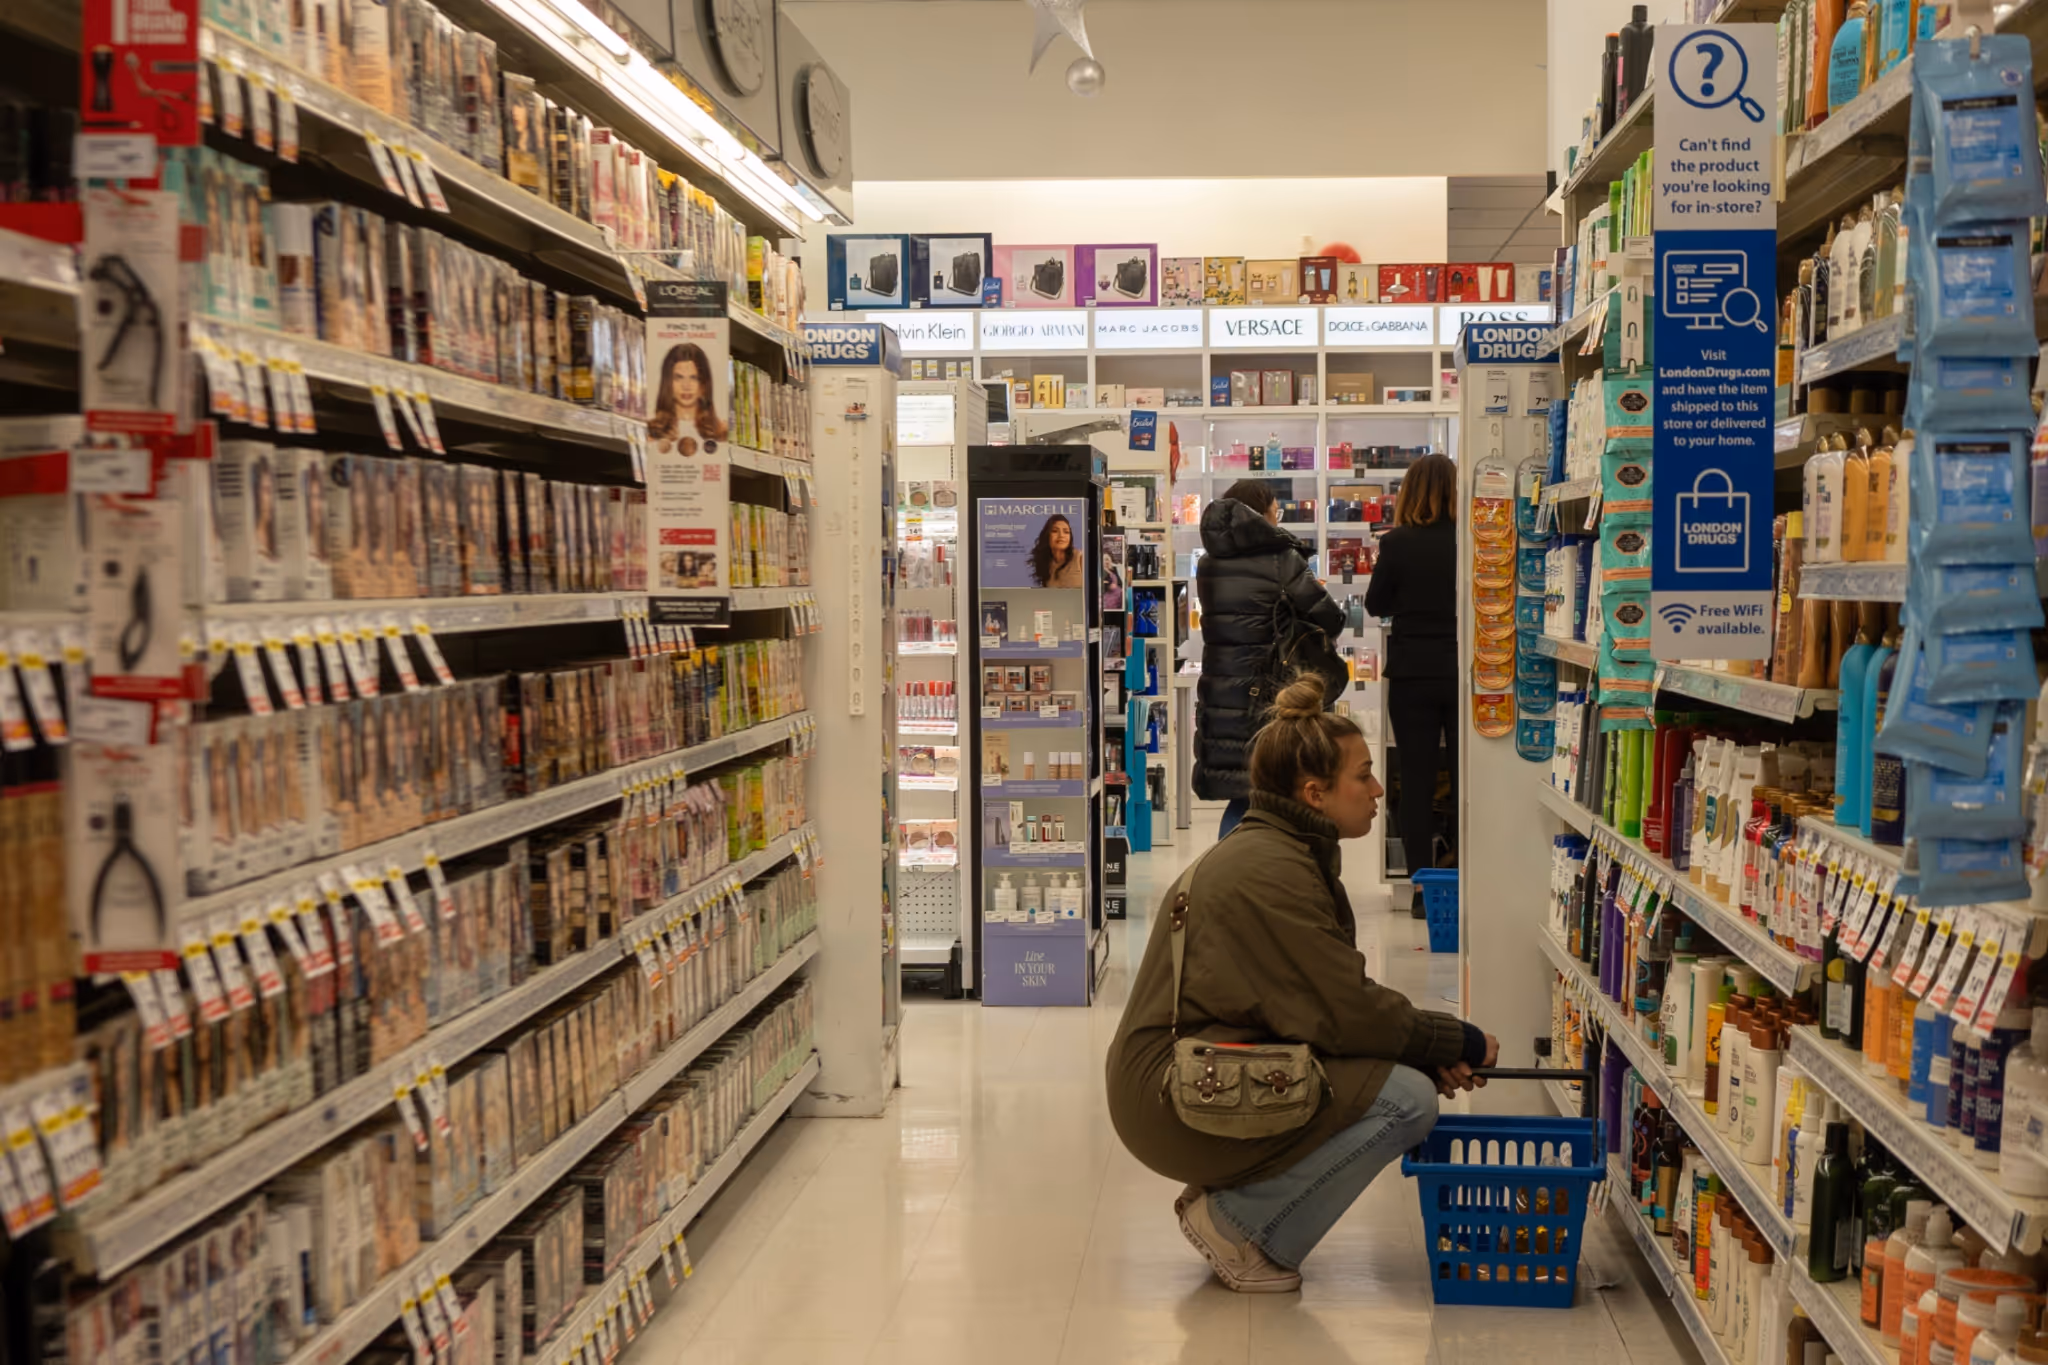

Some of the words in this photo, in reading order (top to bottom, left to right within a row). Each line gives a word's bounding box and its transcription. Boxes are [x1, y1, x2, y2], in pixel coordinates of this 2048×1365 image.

[1679, 138, 1718, 152] Can't
[1721, 137, 1751, 151] find
[1671, 159, 1695, 172] the
[1700, 159, 1760, 176] product
[1662, 179, 1709, 195] you're
[1713, 179, 1771, 195] looking
[1671, 200, 1692, 214] for
[1696, 200, 1762, 214] in-store?
[928, 322, 966, 340] Klein
[983, 324, 1034, 337] GIORGIO
[1041, 324, 1085, 337] ARMANI
[1098, 324, 1137, 333] MARC
[1142, 324, 1199, 333] JACOBS
[1225, 319, 1304, 336] VERSACE
[1328, 321, 1364, 332] DOLCE
[1371, 321, 1428, 332] GABBANA
[804, 328, 876, 343] ONDON
[1479, 343, 1537, 358] DRUG
[1701, 349, 1727, 361] Visit
[1660, 367, 1770, 380] LondonDrugs.com
[1662, 384, 1685, 395] and
[1687, 384, 1717, 395] have
[1719, 384, 1738, 394] the
[1741, 383, 1767, 394] item
[1671, 400, 1719, 413] shipped
[1721, 402, 1734, 412] to
[1737, 400, 1758, 412] this
[1663, 419, 1692, 430] store
[1696, 420, 1708, 430] or
[1711, 417, 1766, 430] delivered
[1674, 436, 1686, 446] to
[1689, 437, 1715, 449] your
[1718, 435, 1755, 446] home.
[1000, 504, 1079, 515] MARCELLE
[1684, 522, 1742, 534] LONDON
[1688, 533, 1737, 545] DRUGS
[1700, 605, 1730, 617] Free
[1733, 604, 1763, 617] WiFi
[1697, 622, 1765, 635] available.
[1025, 951, 1049, 961] Live
[1015, 962, 1025, 974] IN
[1027, 962, 1056, 974] YOUR
[1022, 975, 1047, 987] SKIN
